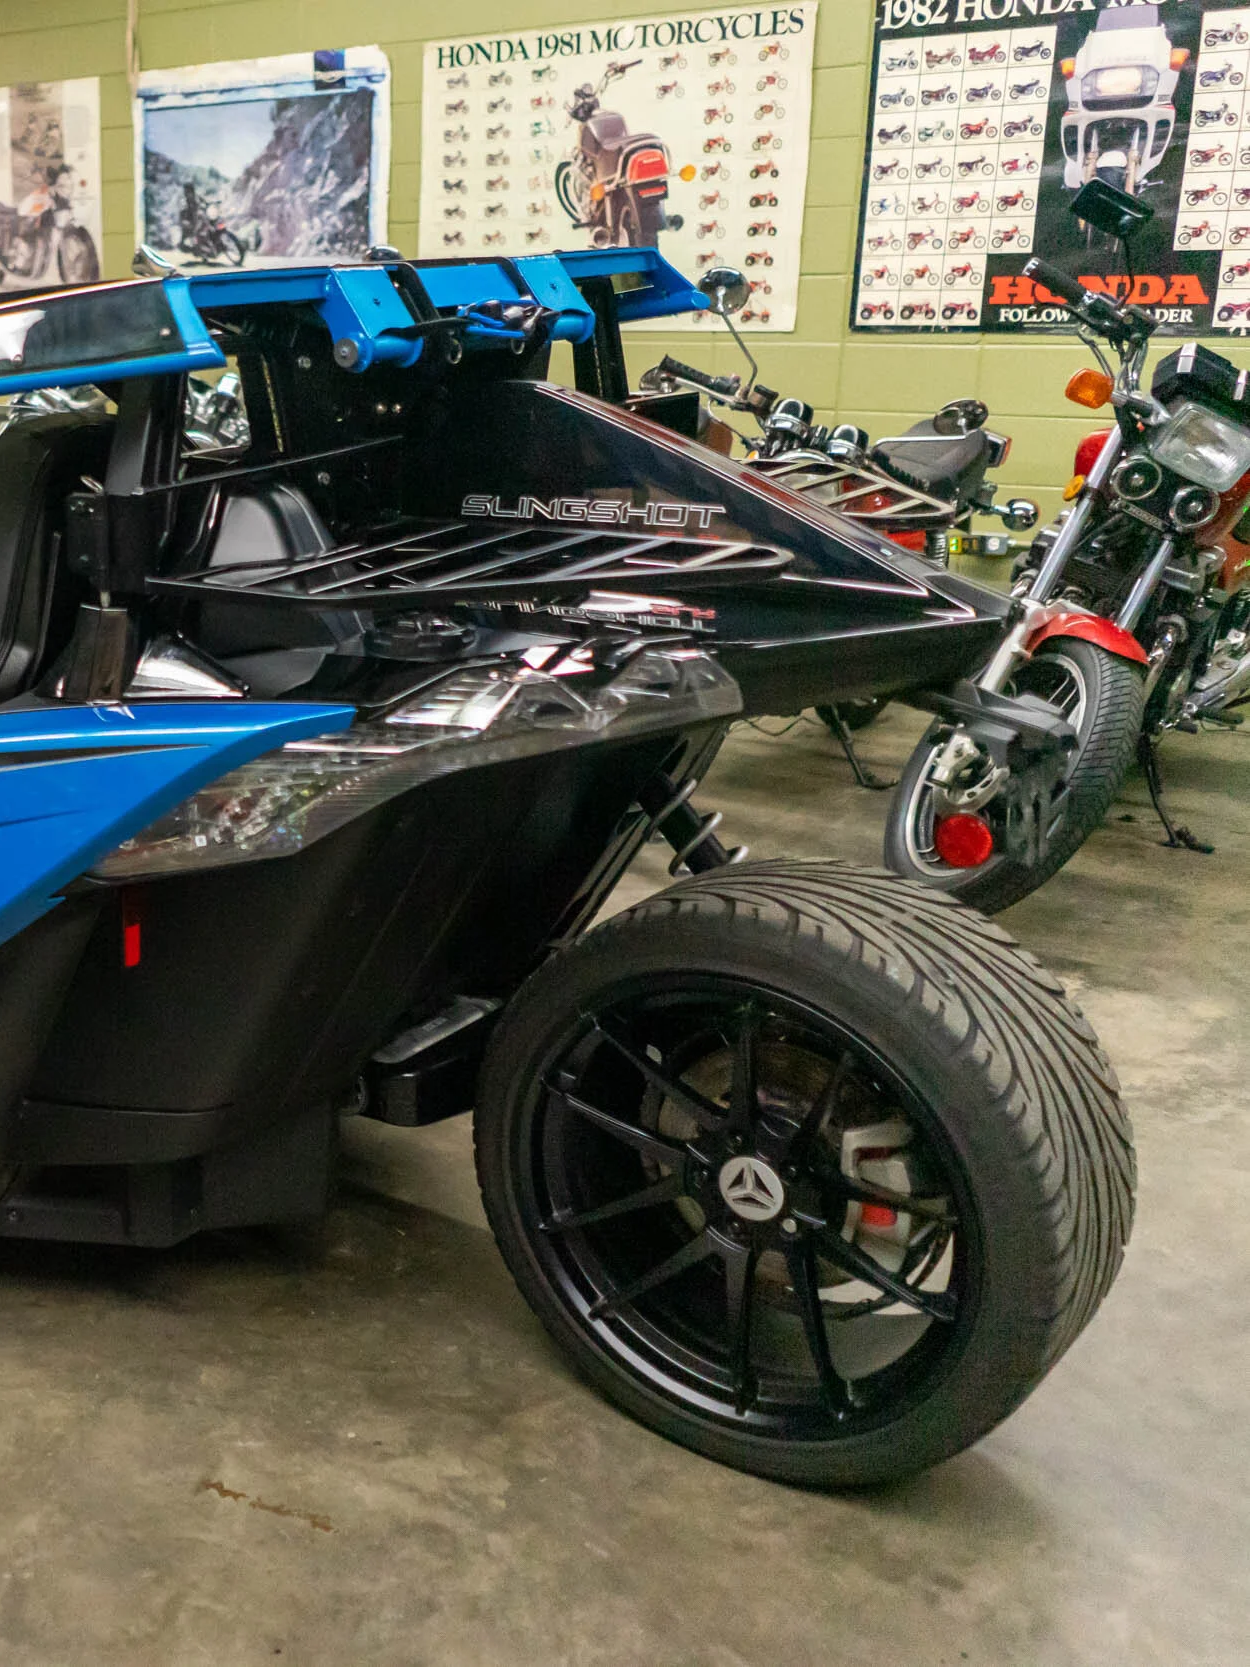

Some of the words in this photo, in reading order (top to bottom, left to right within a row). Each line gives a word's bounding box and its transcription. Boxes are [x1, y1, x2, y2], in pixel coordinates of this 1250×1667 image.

[879, 0, 949, 30] 1982
[437, 37, 530, 69] HONDA
[537, 32, 583, 60] 1981
[589, 7, 805, 54] MOTORCYCLES
[461, 494, 727, 529] SLINGSHOT
